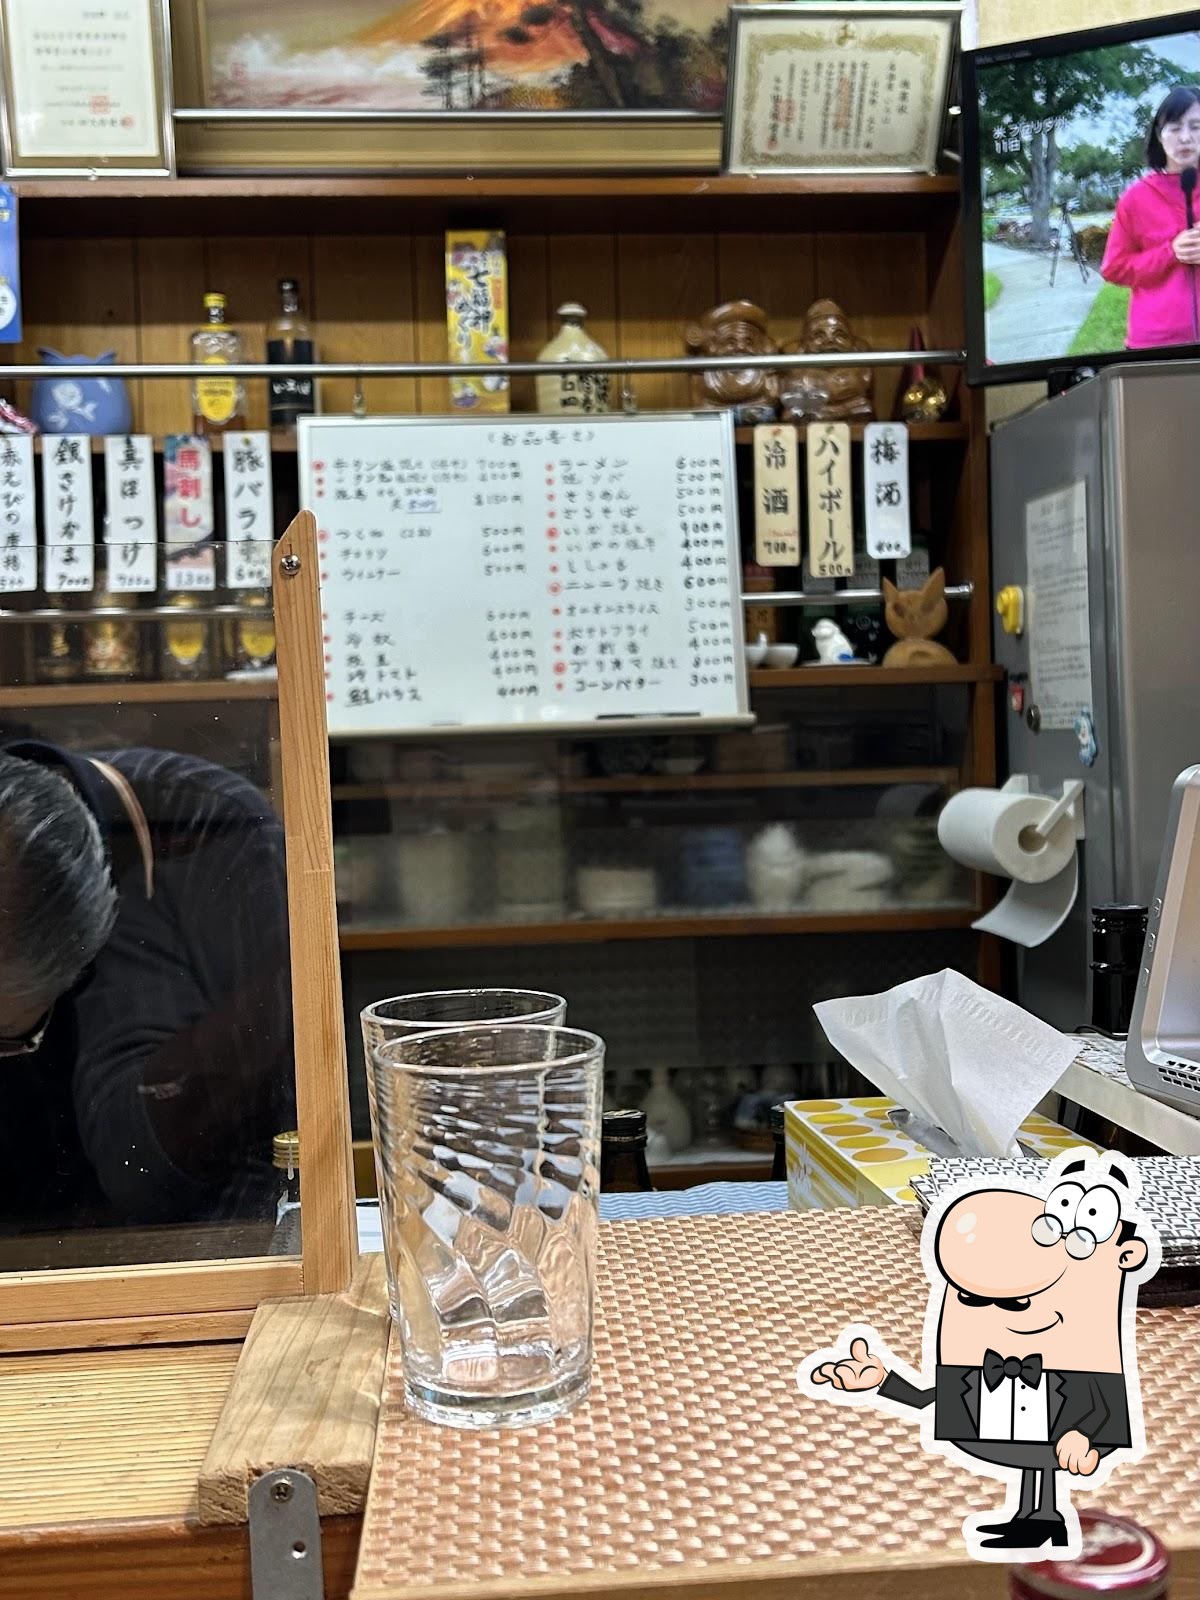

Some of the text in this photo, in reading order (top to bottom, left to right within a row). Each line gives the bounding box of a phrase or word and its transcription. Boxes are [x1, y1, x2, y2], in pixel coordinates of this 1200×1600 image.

[176, 448, 202, 528] 馬刺し
[559, 456, 630, 472] ラーメン
[763, 440, 789, 515] 冷酒
[870, 438, 902, 507] 梅酒
[814, 437, 846, 562] ハイボール
[344, 609, 385, 624] チーズ
[575, 674, 733, 692] コーンバター 300円
